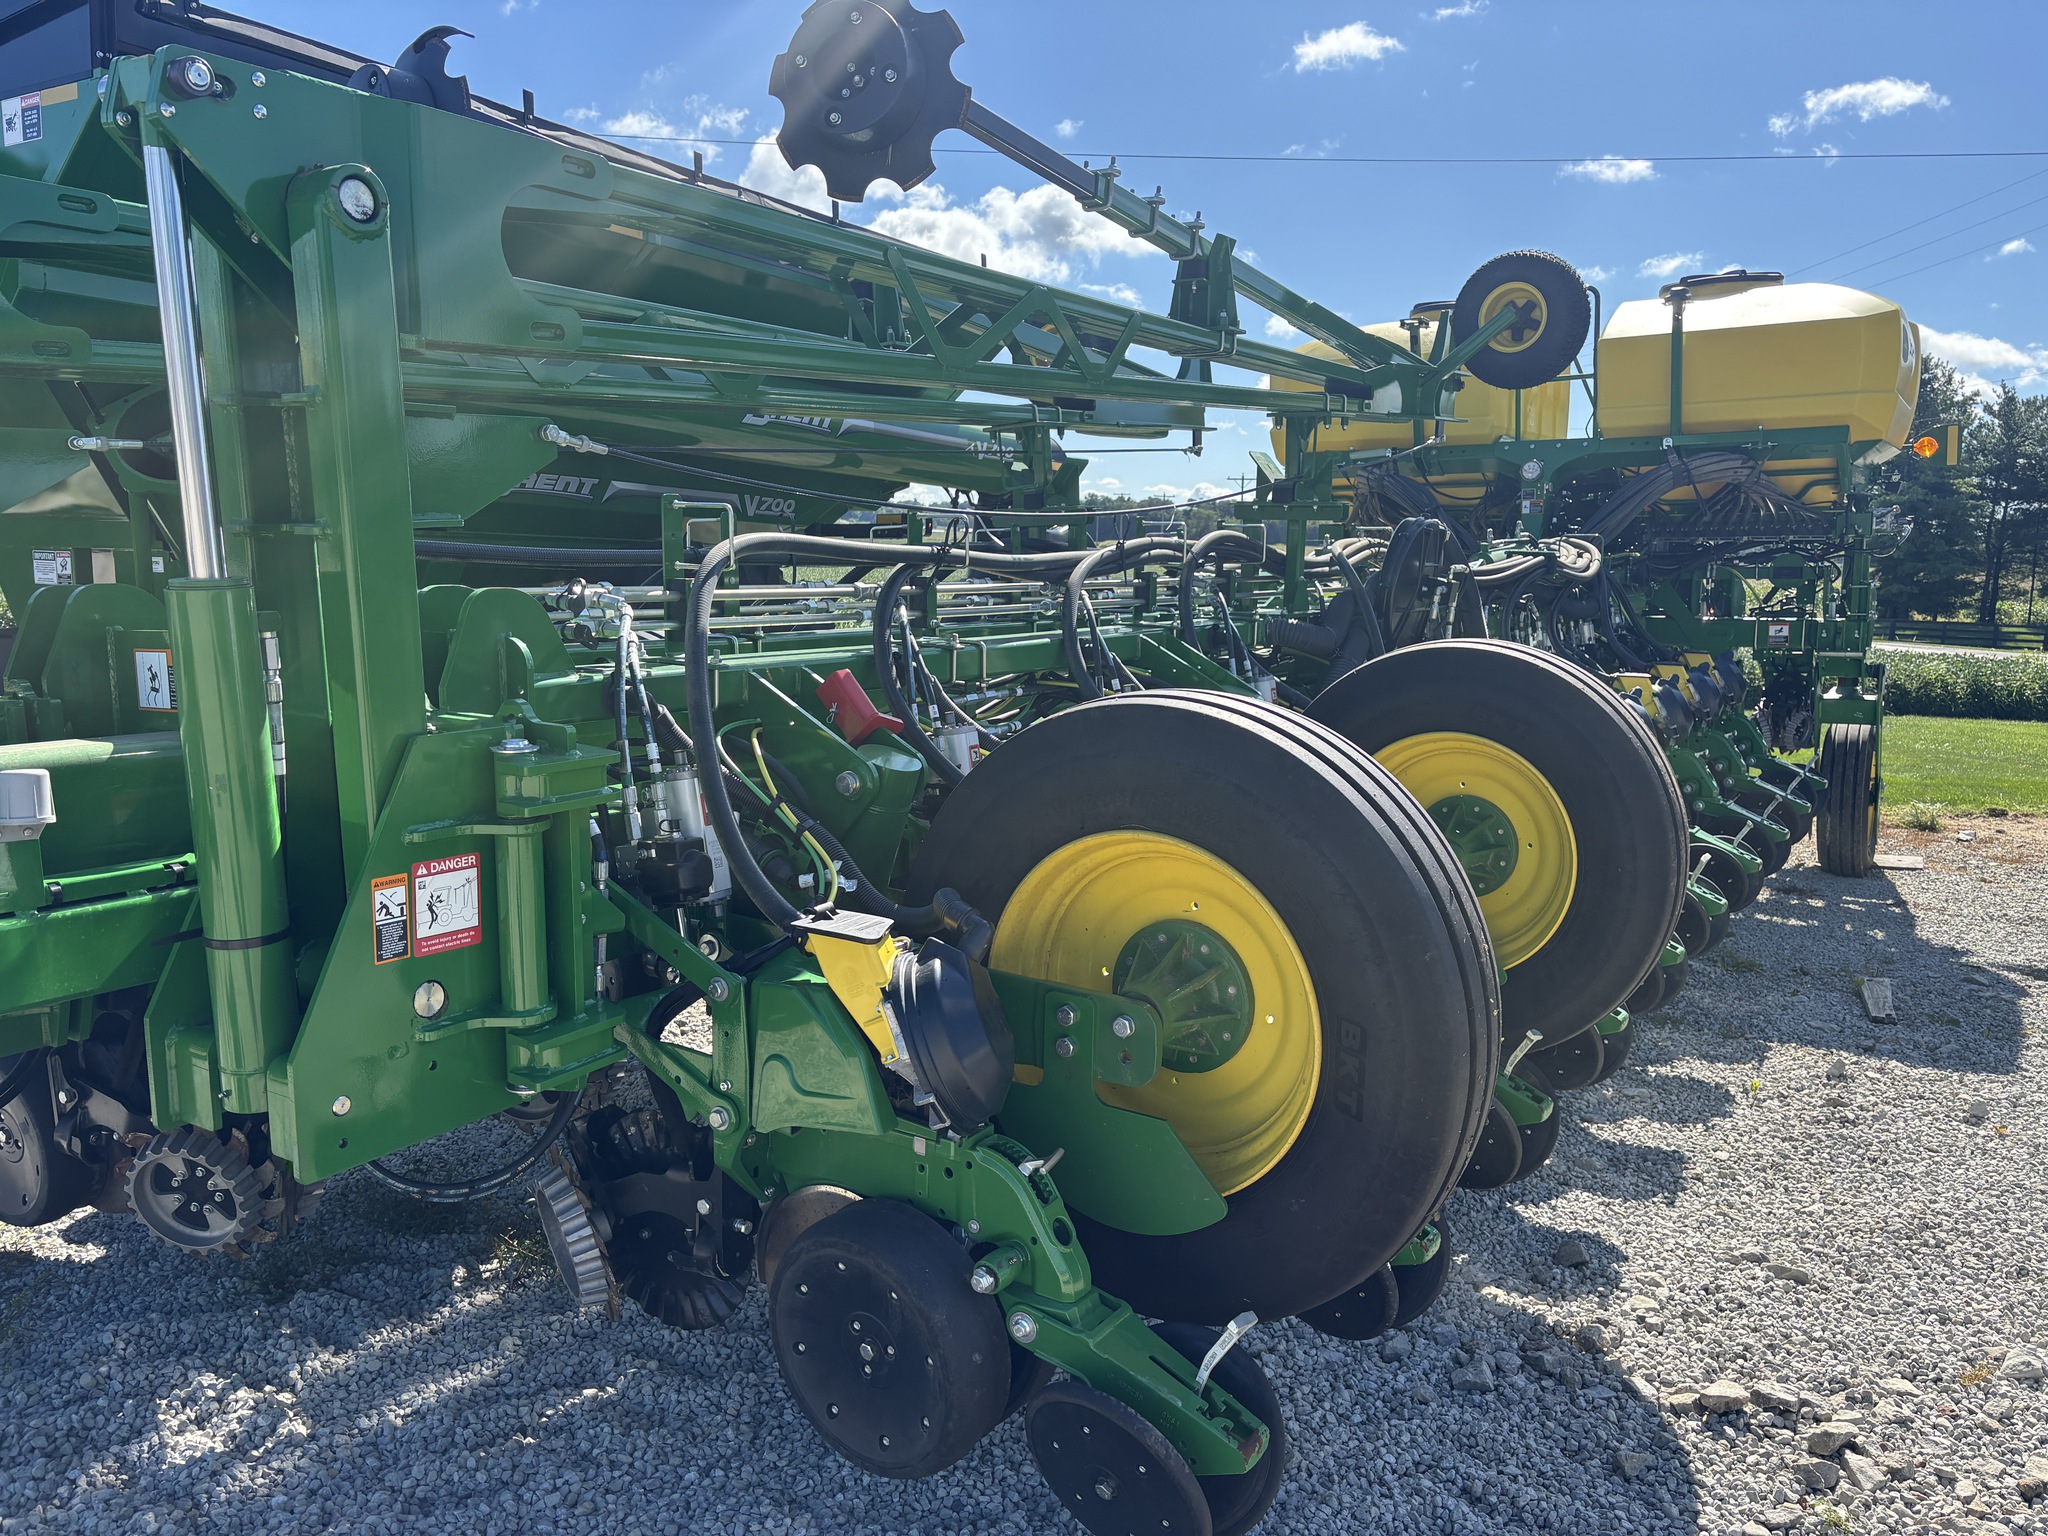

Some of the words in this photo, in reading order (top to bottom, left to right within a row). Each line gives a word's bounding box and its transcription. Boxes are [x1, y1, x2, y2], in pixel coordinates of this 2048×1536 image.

[744, 494, 796, 517] V700
[430, 855, 476, 874] DANGER
[379, 877, 406, 887] WARNING
[429, 943, 445, 951] contact
[1337, 1020, 1363, 1118] BKT
